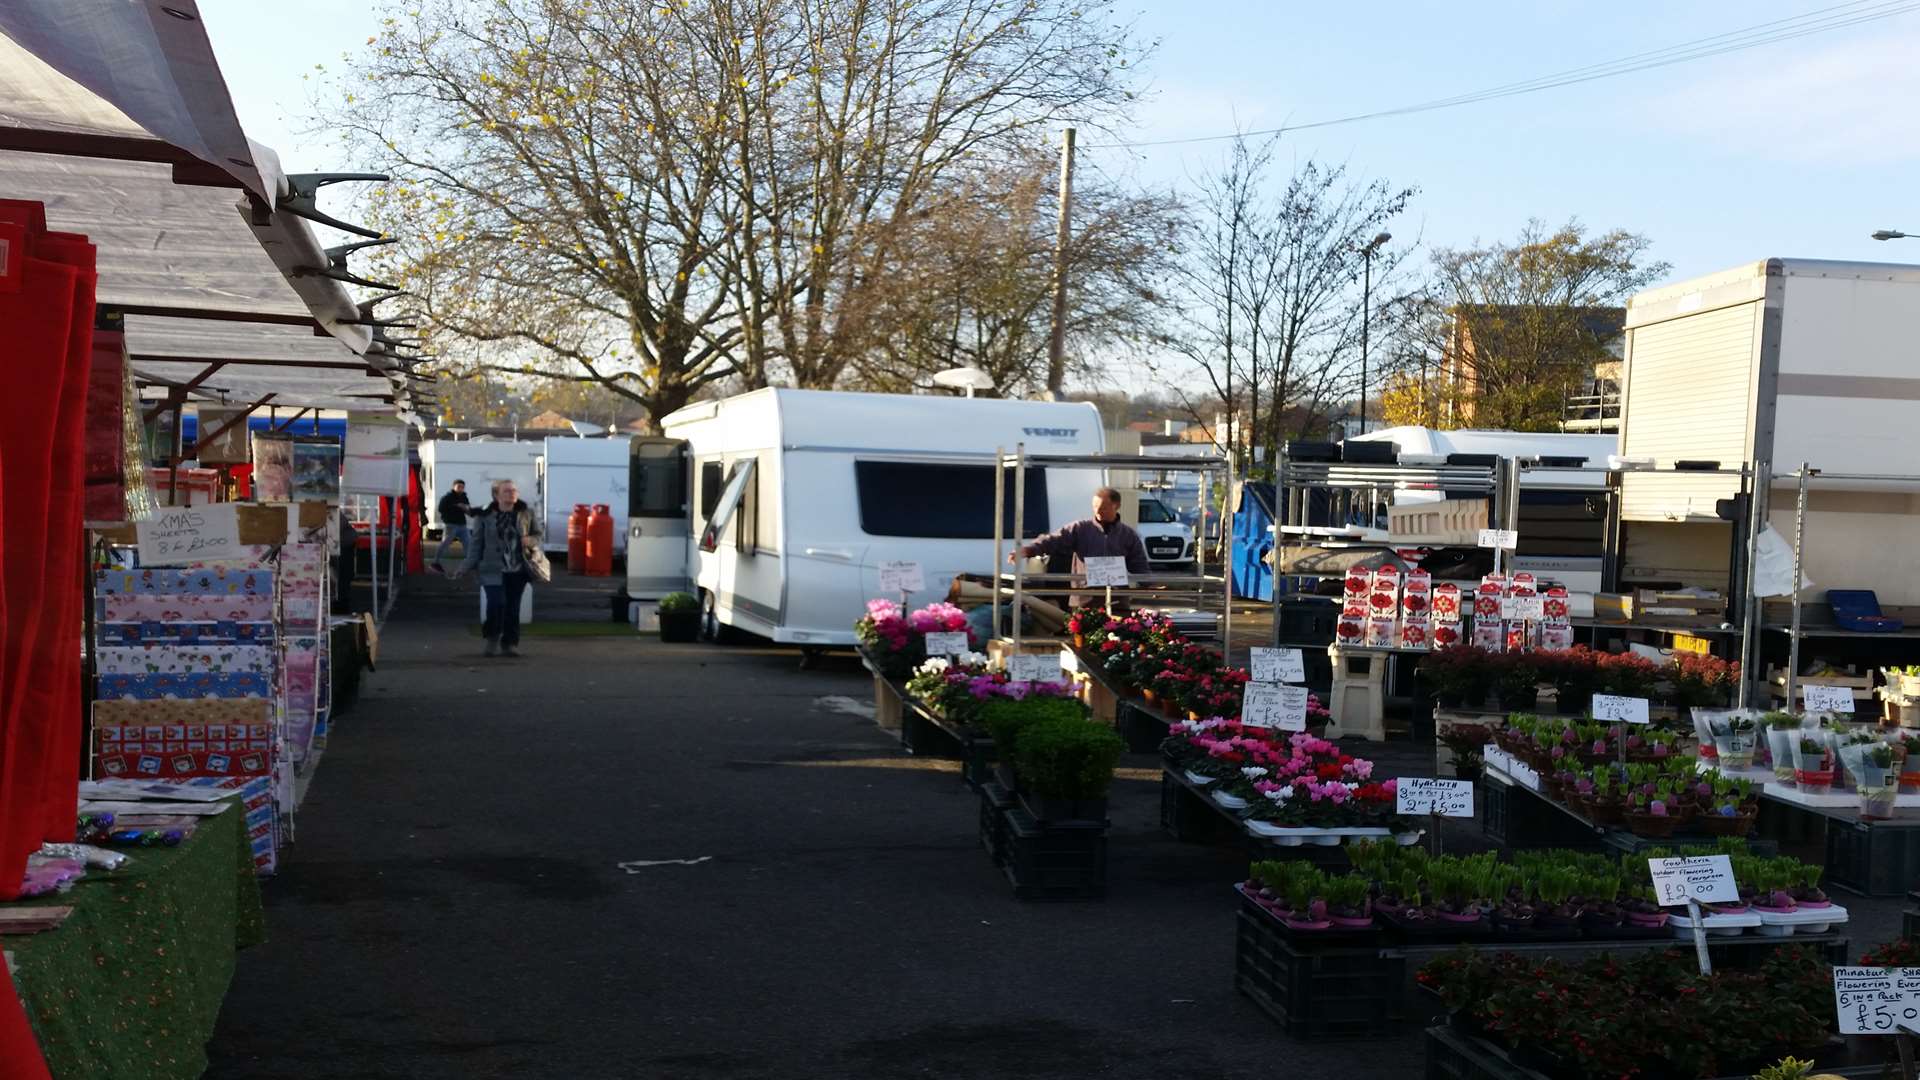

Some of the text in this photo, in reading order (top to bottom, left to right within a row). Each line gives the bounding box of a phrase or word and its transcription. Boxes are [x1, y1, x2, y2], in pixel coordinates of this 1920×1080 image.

[1405, 799, 1417, 811] 2
[1837, 980, 1891, 990] Flowering
[1840, 992, 1850, 1005] 6
